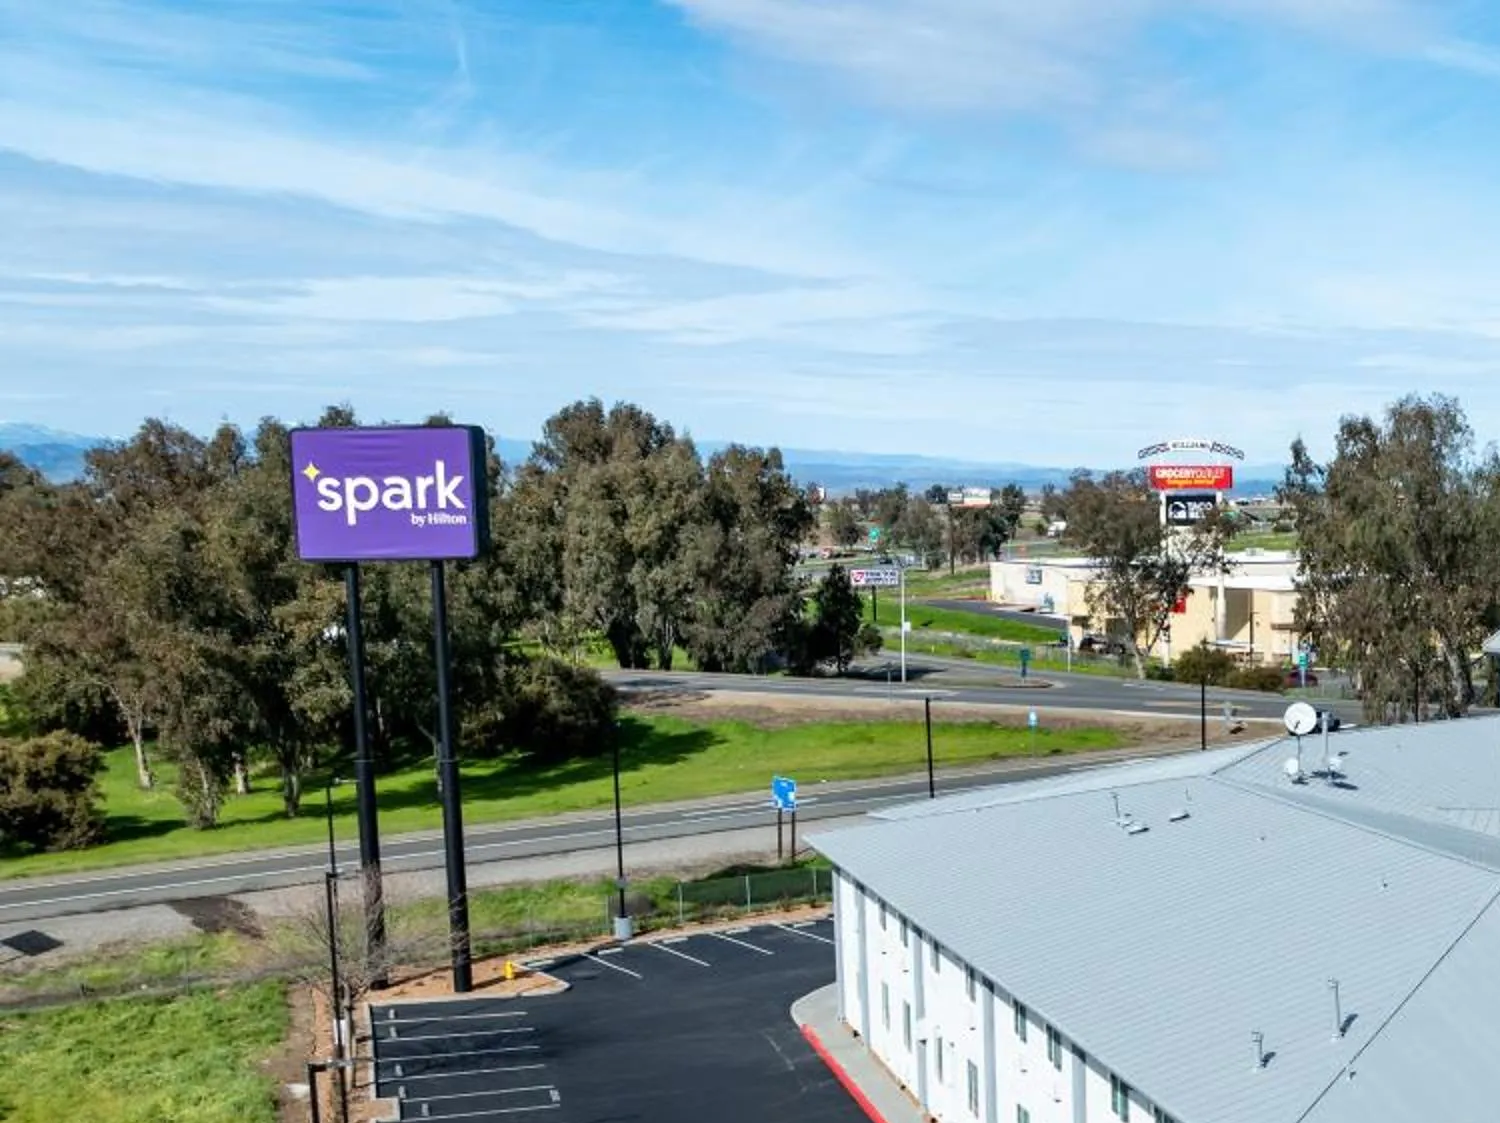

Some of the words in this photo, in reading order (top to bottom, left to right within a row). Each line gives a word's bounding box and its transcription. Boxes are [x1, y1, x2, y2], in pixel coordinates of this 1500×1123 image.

[316, 459, 466, 526] spark
[411, 512, 426, 528] by
[428, 512, 467, 525] Hilton
